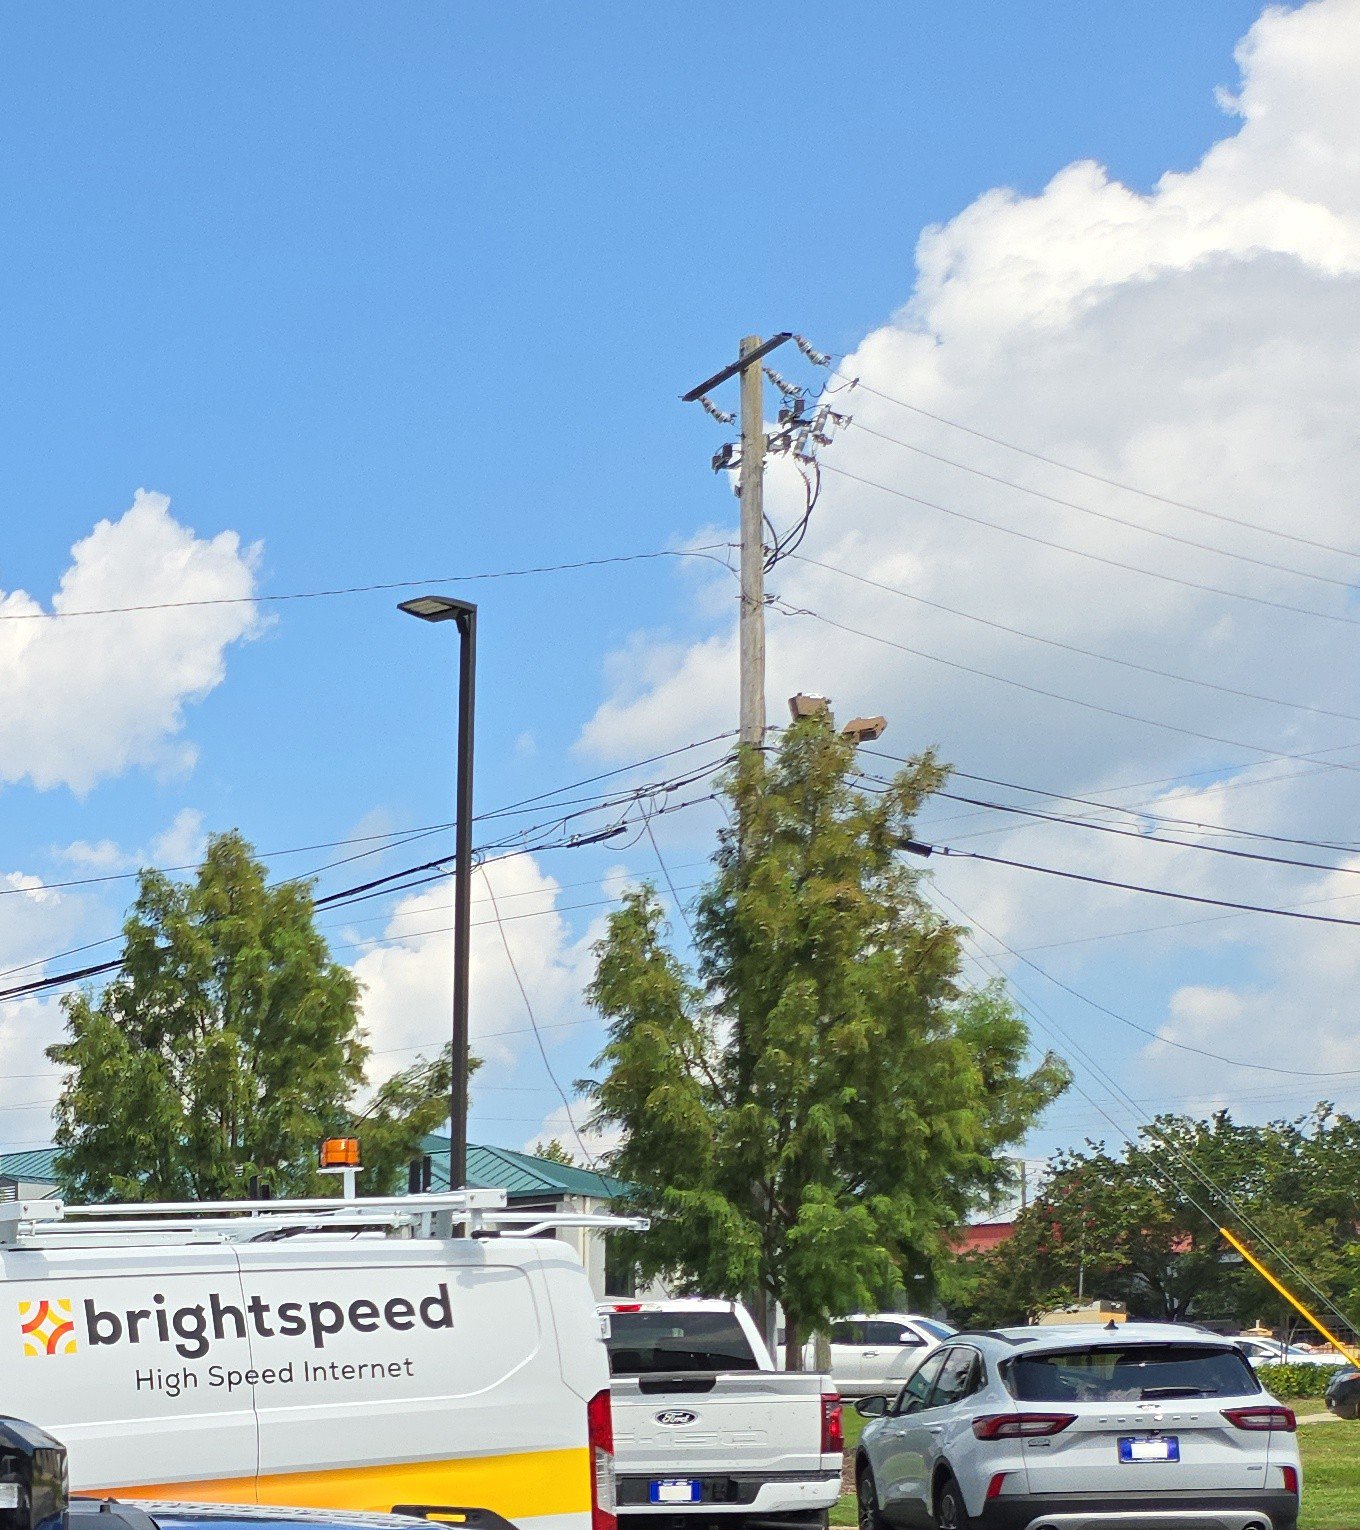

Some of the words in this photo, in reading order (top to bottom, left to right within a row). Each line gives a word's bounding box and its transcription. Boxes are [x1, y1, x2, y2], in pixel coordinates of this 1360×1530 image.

[83, 1283, 454, 1359] brightspeed
[135, 1367, 198, 1397] High
[208, 1361, 294, 1393] Speed
[304, 1358, 414, 1382] Internet
[661, 1410, 691, 1425] Ford
